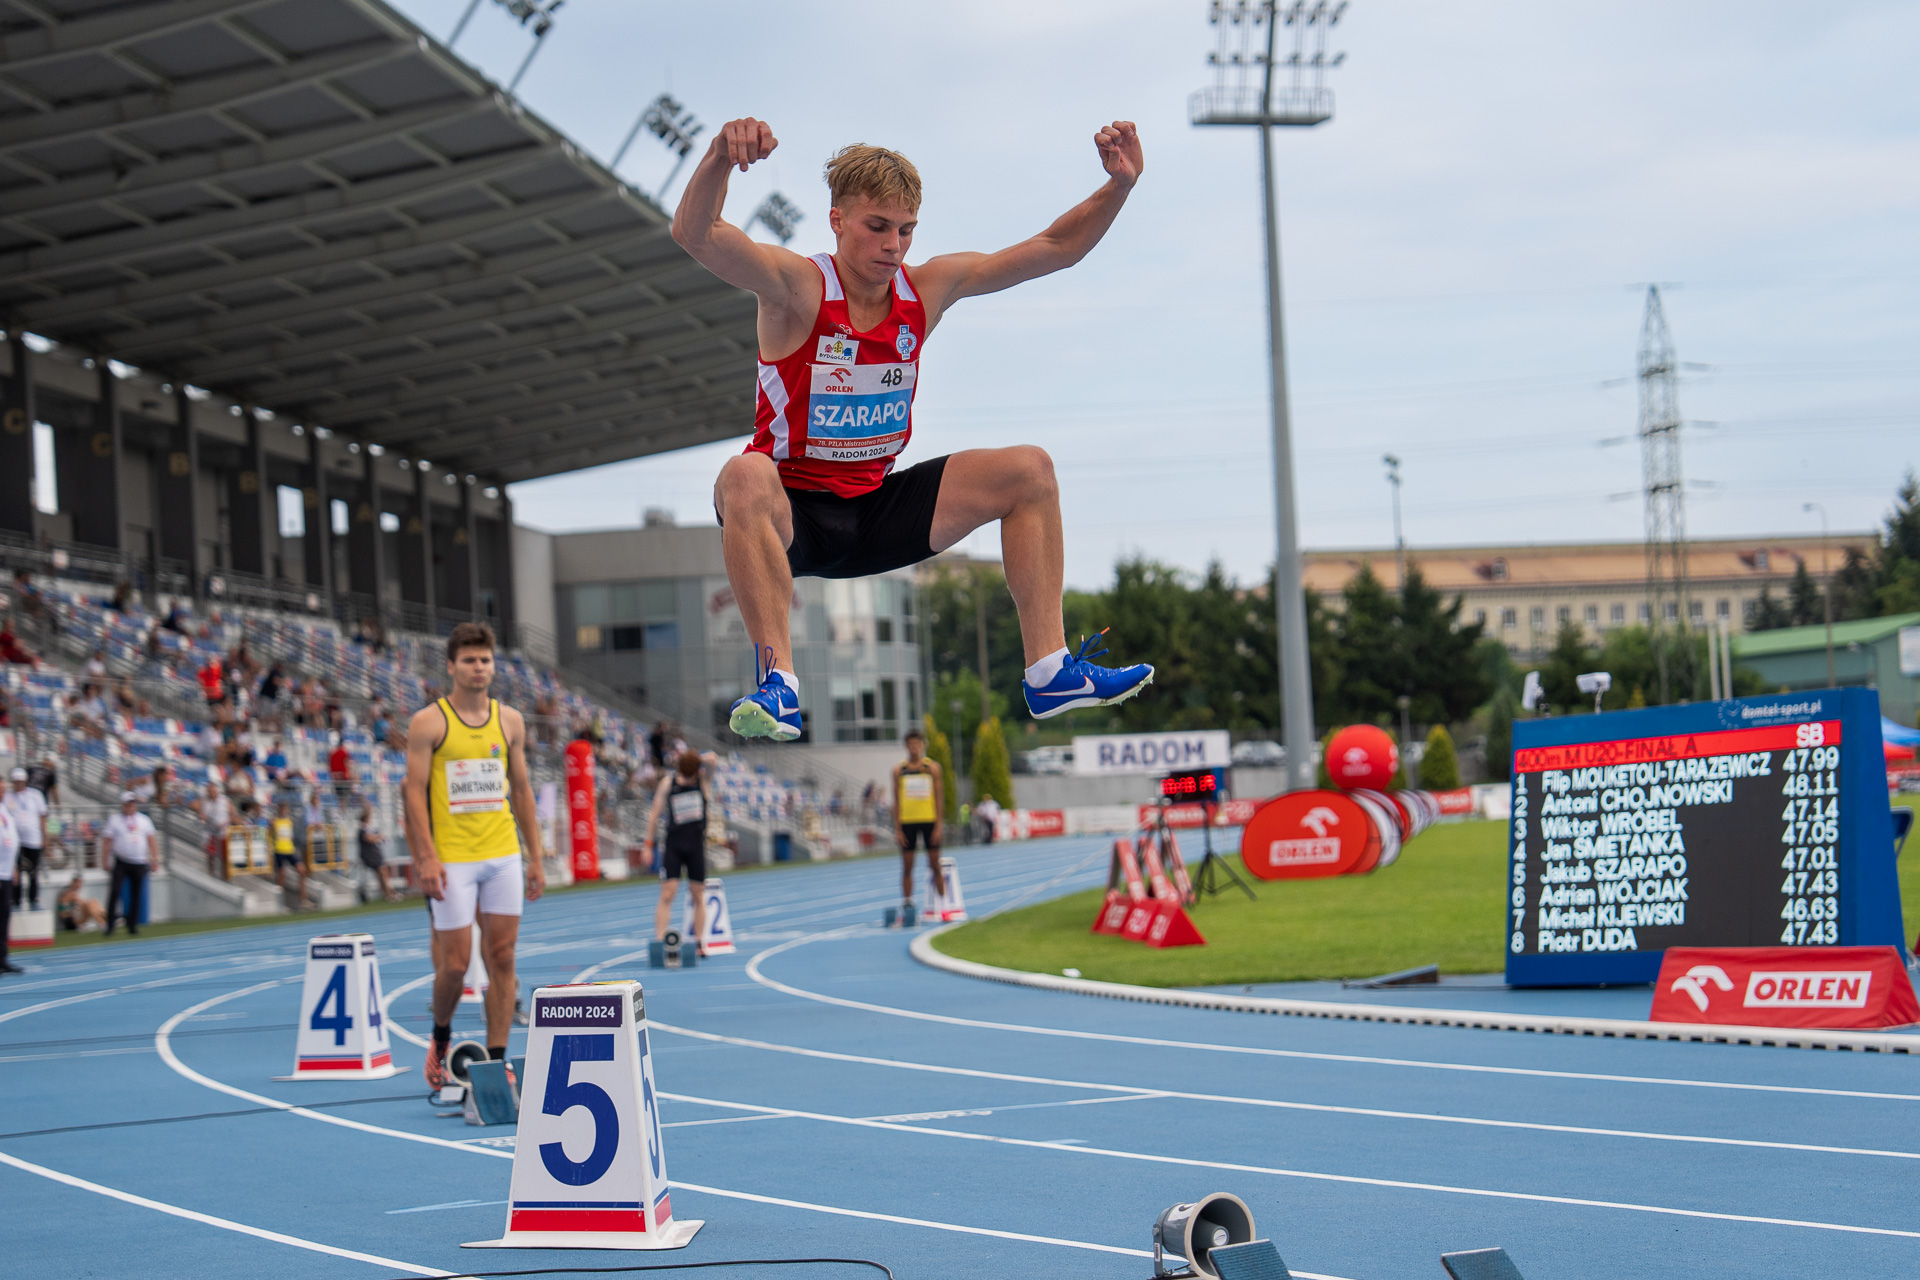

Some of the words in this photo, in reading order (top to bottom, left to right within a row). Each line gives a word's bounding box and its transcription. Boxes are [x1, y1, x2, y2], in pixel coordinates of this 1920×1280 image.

[881, 368, 903, 387] 48
[813, 400, 907, 427] SZARAPO
[832, 450, 867, 459] RADOM
[869, 446, 887, 456] 2024
[1684, 737, 1697, 754] A
[1796, 723, 1825, 748] SB
[1100, 740, 1206, 766] RADOM
[1516, 773, 1528, 795] 1
[1782, 746, 1840, 773] 47.99
[1514, 796, 1528, 818] 2
[1541, 790, 1598, 816] Antoni
[1600, 780, 1733, 812] CHOJNOWSKI
[1782, 771, 1839, 797] 48.11
[1514, 818, 1527, 840] 3
[1540, 816, 1599, 840] Wiktor
[1601, 807, 1683, 835] WRÓBEL
[1782, 796, 1839, 822] 47.14
[1513, 840, 1527, 862] 4
[1540, 838, 1572, 861] Jan
[1781, 819, 1839, 845] 47.05
[1513, 863, 1526, 885] 5
[1540, 860, 1592, 884] Jakub
[1594, 854, 1687, 881] SZARAPO
[1781, 846, 1838, 871] 47.01
[1512, 886, 1526, 908] 6
[1539, 883, 1596, 907] Adrian
[1781, 870, 1838, 896] 47.43
[707, 896, 724, 935] 2
[1512, 908, 1526, 930] 7
[1597, 901, 1685, 928] KIJEWSKI
[1780, 897, 1838, 921] 46.63
[1511, 931, 1525, 953] 8
[1538, 930, 1581, 953] Piotr
[1582, 927, 1638, 952] DUDA
[1780, 920, 1838, 946] 47.43
[310, 964, 353, 1046] 4
[1754, 976, 1862, 1003] ORLEN
[542, 1006, 583, 1019] RADOM
[586, 1006, 616, 1018] 2024
[539, 1034, 619, 1186] 5
